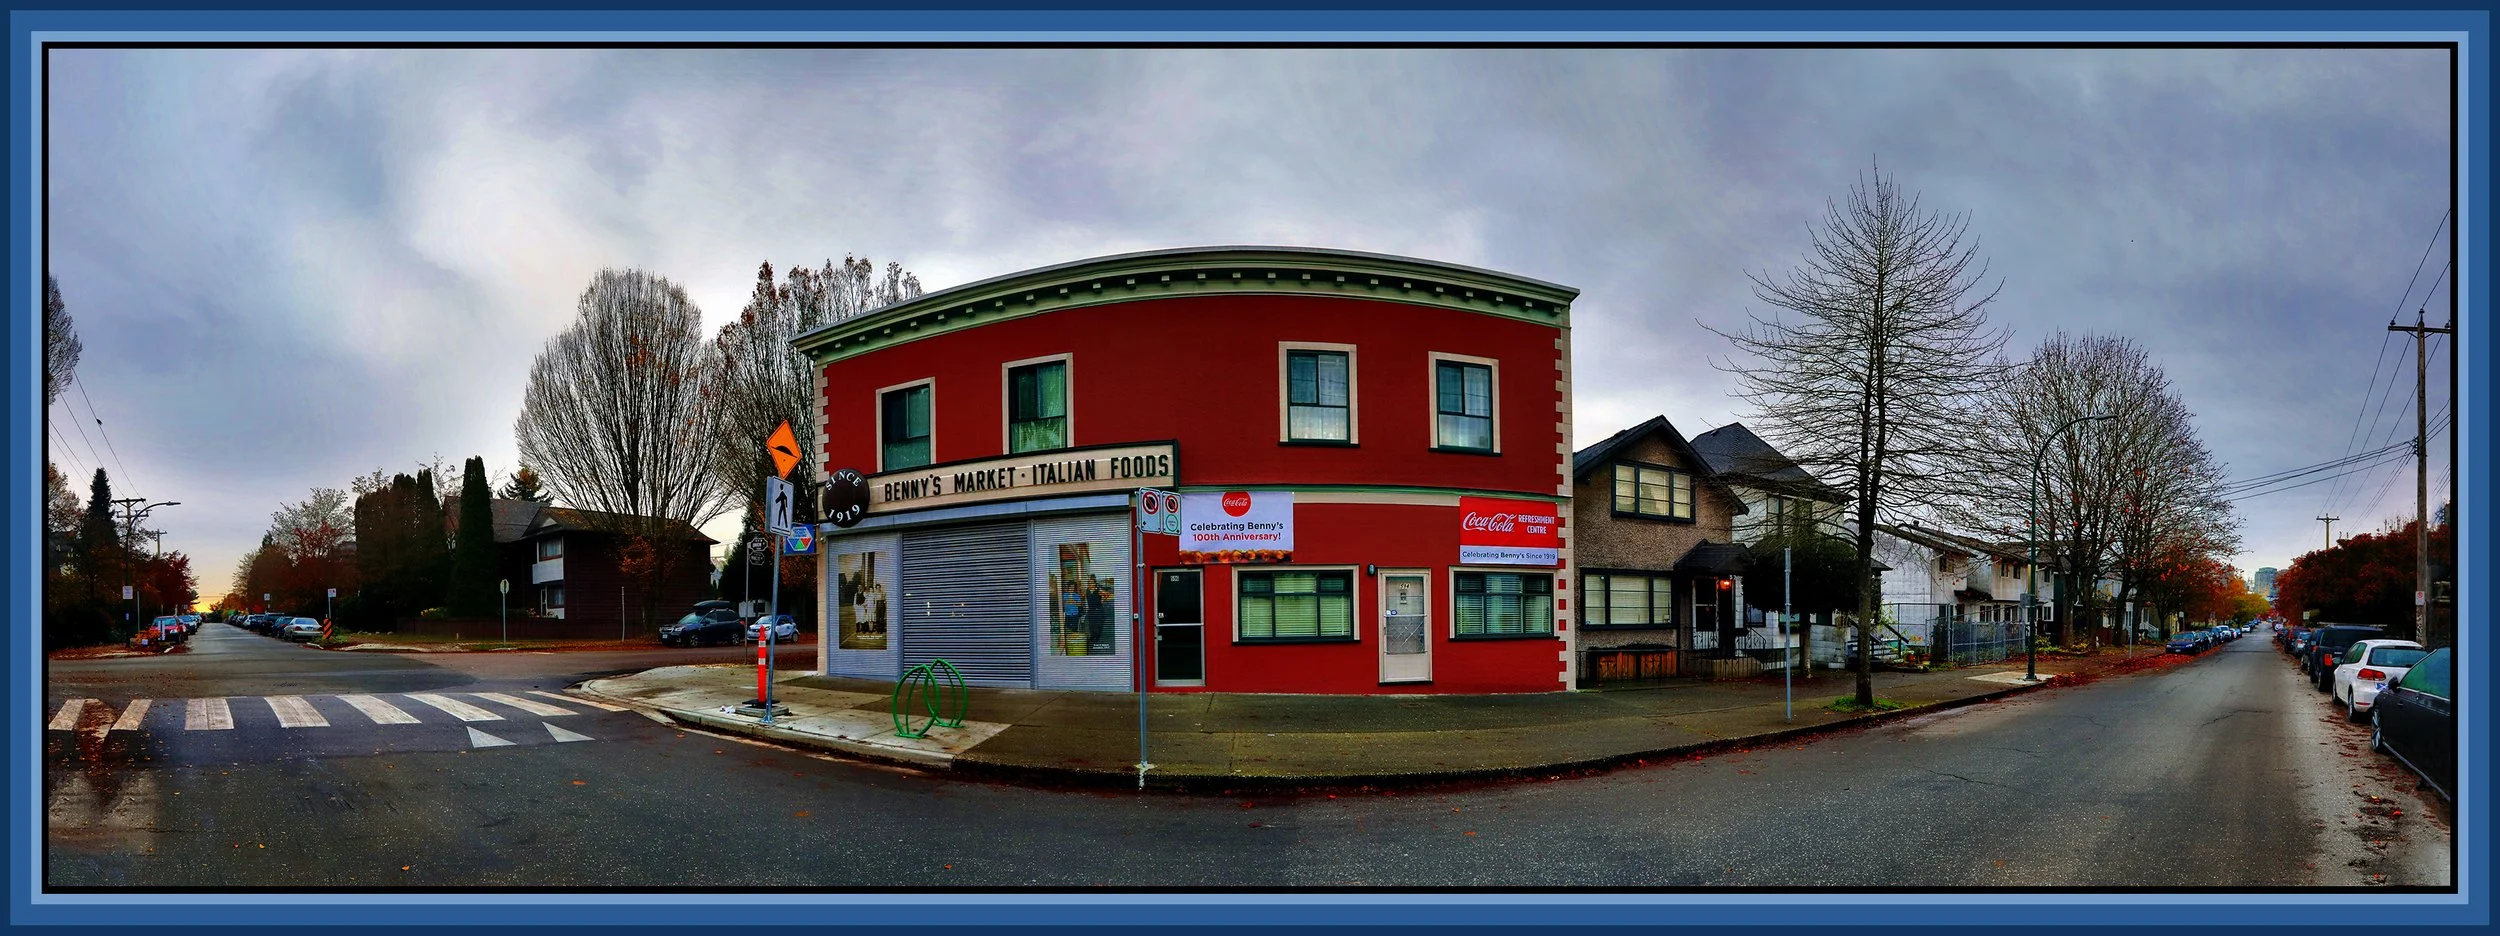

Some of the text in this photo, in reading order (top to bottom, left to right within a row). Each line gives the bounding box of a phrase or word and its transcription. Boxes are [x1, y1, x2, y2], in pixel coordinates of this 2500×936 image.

[826, 471, 862, 491] SINCE
[884, 454, 1169, 502] BENNY'S MARKET ITALIAN FOODS
[828, 504, 860, 523] 1919
[1518, 514, 1555, 524] REFRESHMENT
[1190, 522, 1245, 534] Celebrating
[1247, 521, 1284, 533] Benny's
[1462, 511, 1517, 533] Coca-Cola
[1526, 525, 1547, 534] CENTRE
[1193, 532, 1281, 543] 100th Anniversary!
[1462, 551, 1499, 559] Celebrating
